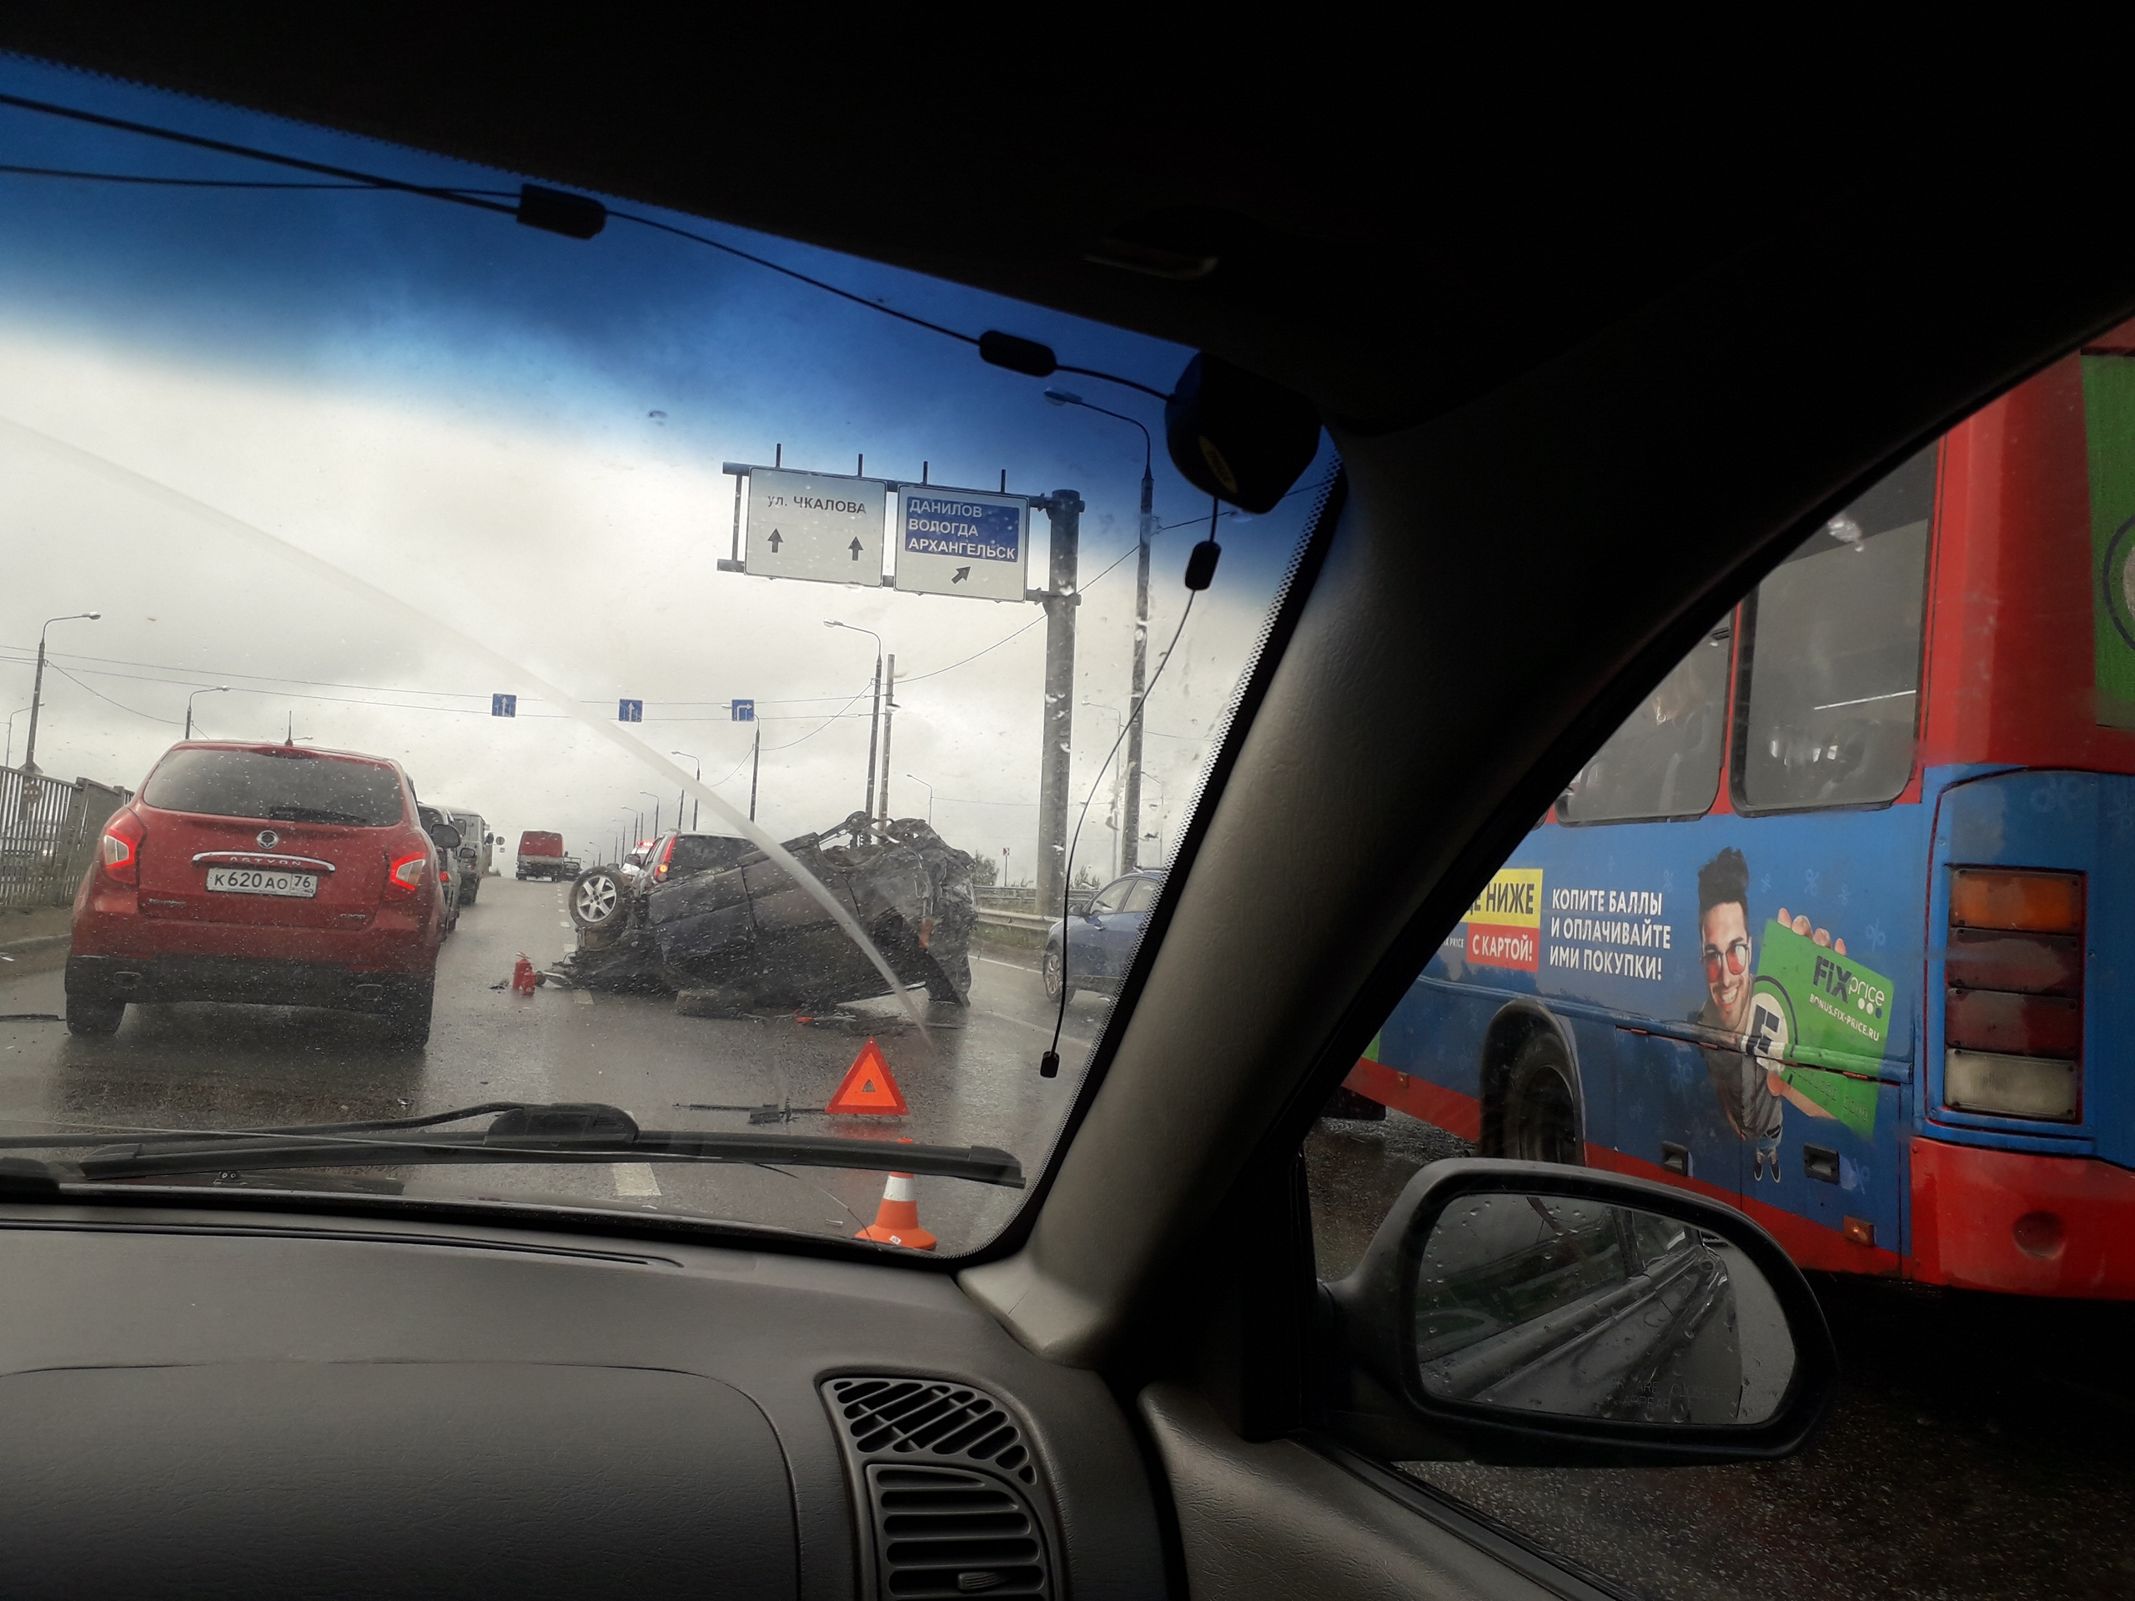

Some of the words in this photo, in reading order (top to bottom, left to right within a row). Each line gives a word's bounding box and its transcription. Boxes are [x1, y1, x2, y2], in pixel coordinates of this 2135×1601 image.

[767, 495, 788, 508] ул.
[793, 496, 867, 515] ЧКАЛОВА
[909, 499, 983, 519] ДАНИЛОВ
[908, 518, 979, 538] ВОЛОГДА
[908, 538, 1015, 560] АРХАНГЕЛЬСК
[293, 875, 311, 888] 76
[1485, 882, 1535, 915] НИЖЕ
[1552, 888, 1605, 912] КОПИТЕ
[1608, 890, 1663, 916] БАЛЛЫ
[1551, 916, 1560, 938] И
[1563, 917, 1672, 950] ОПЛАЧИВАЙТЕ
[1472, 933, 1480, 955] С
[1482, 933, 1533, 962] КАРТОЙ!
[1549, 944, 1580, 970] ИМИ
[1583, 948, 1662, 981] ПОКУПКИ!
